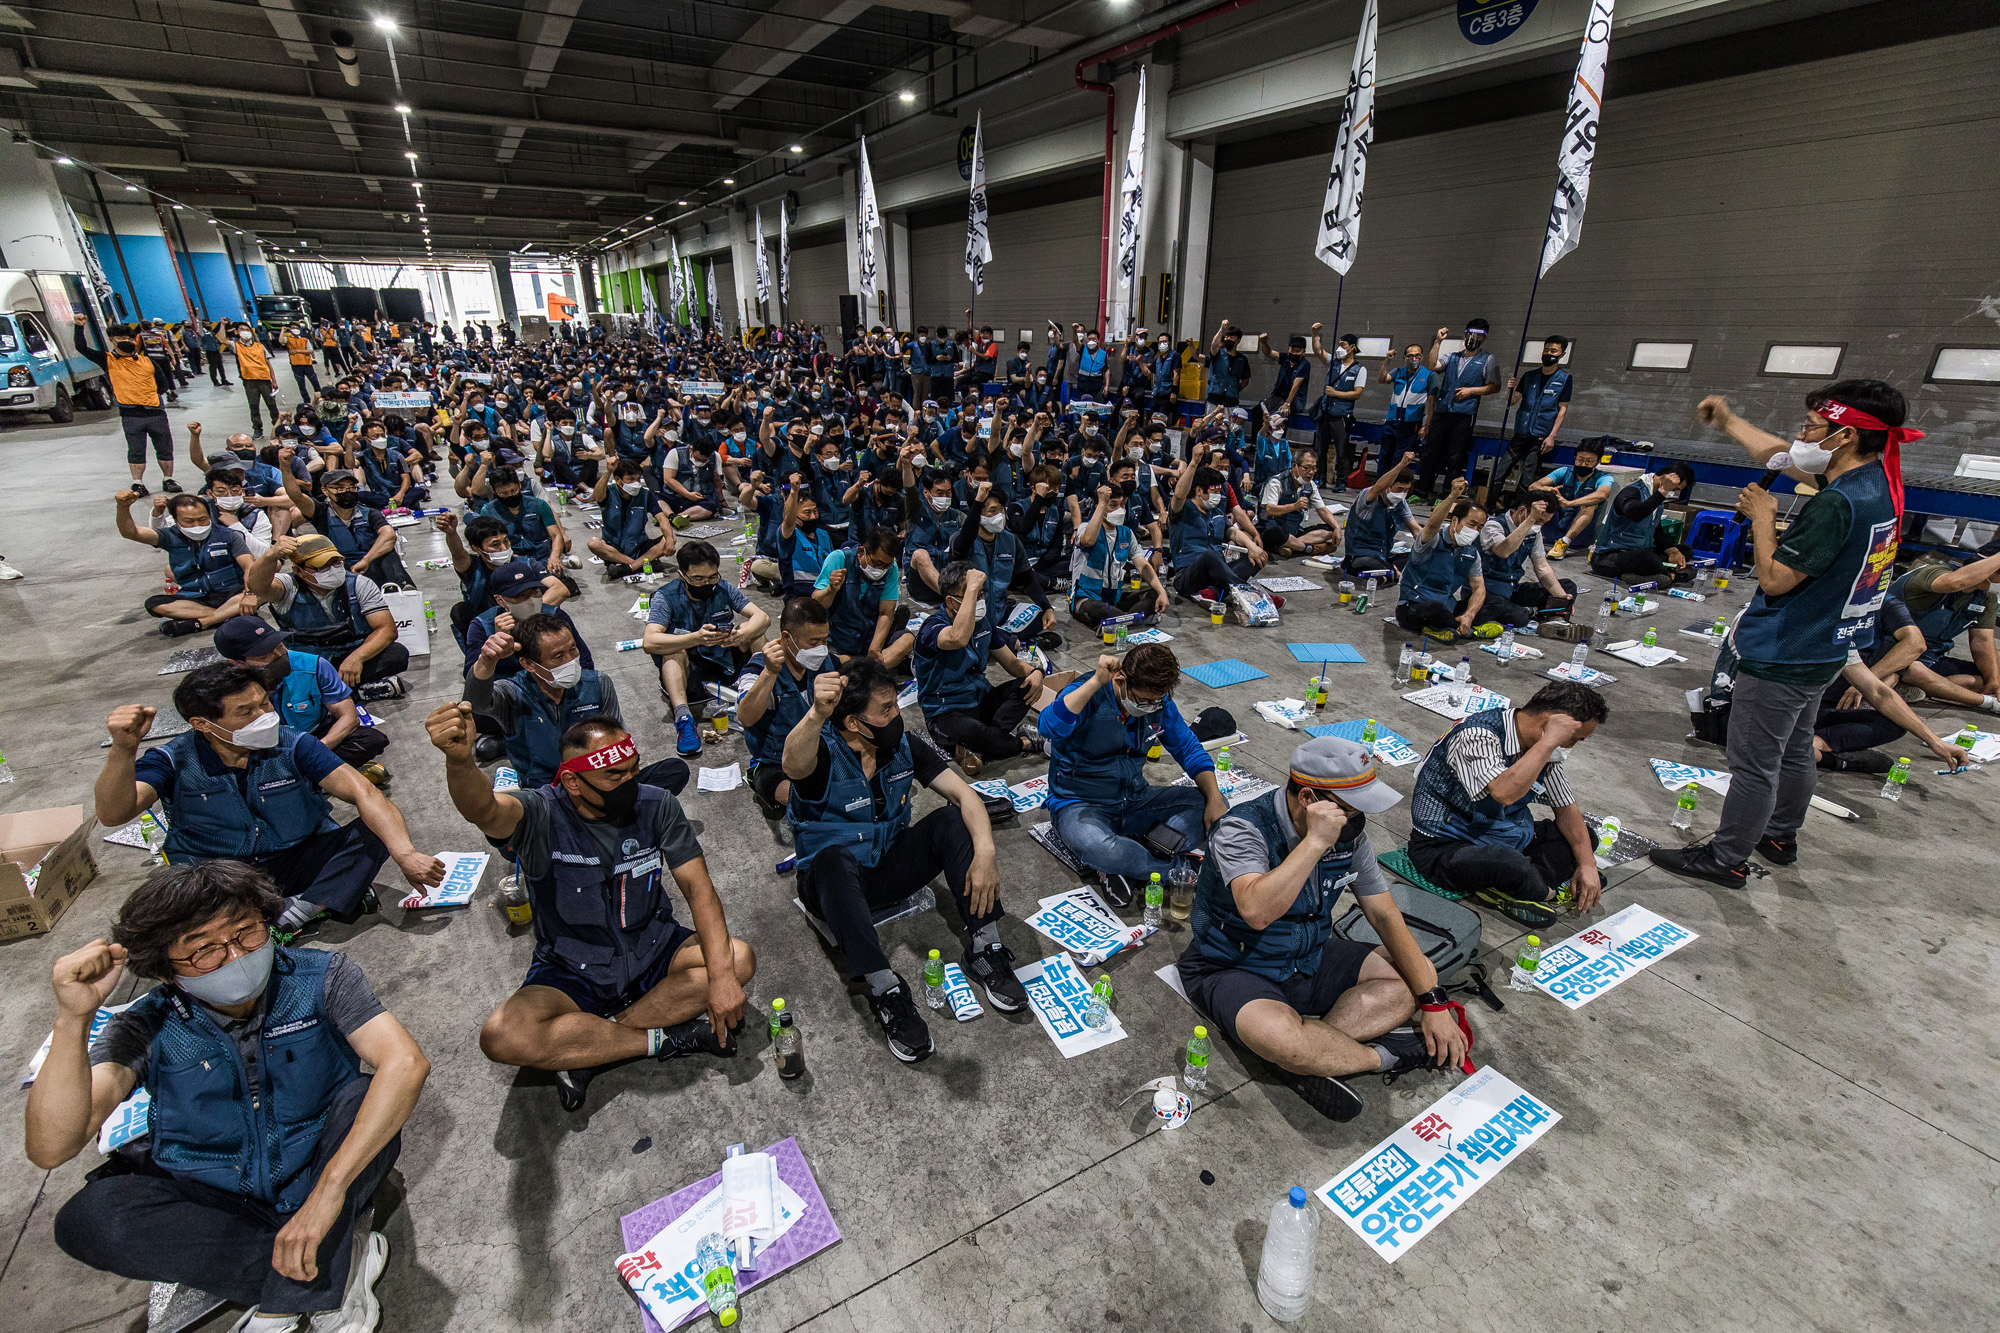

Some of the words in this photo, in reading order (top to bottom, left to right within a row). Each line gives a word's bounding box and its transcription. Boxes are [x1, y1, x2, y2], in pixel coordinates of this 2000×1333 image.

[1469, 4, 1524, 35] C동3층
[587, 745, 622, 770] 단결
[27, 921, 39, 932] 2
[1056, 903, 1119, 939] 분류작업!
[1578, 928, 1612, 946] 즉각
[1549, 951, 1637, 1002] 우정본부가
[1616, 921, 1690, 961] 책임져라!
[1024, 981, 1079, 1035] 분류작업!
[1410, 1112, 1453, 1142] 즉각
[1333, 1146, 1412, 1213] 분류작업!
[1361, 1152, 1480, 1248] 우정본부가
[1456, 1094, 1552, 1165] 책임져라!
